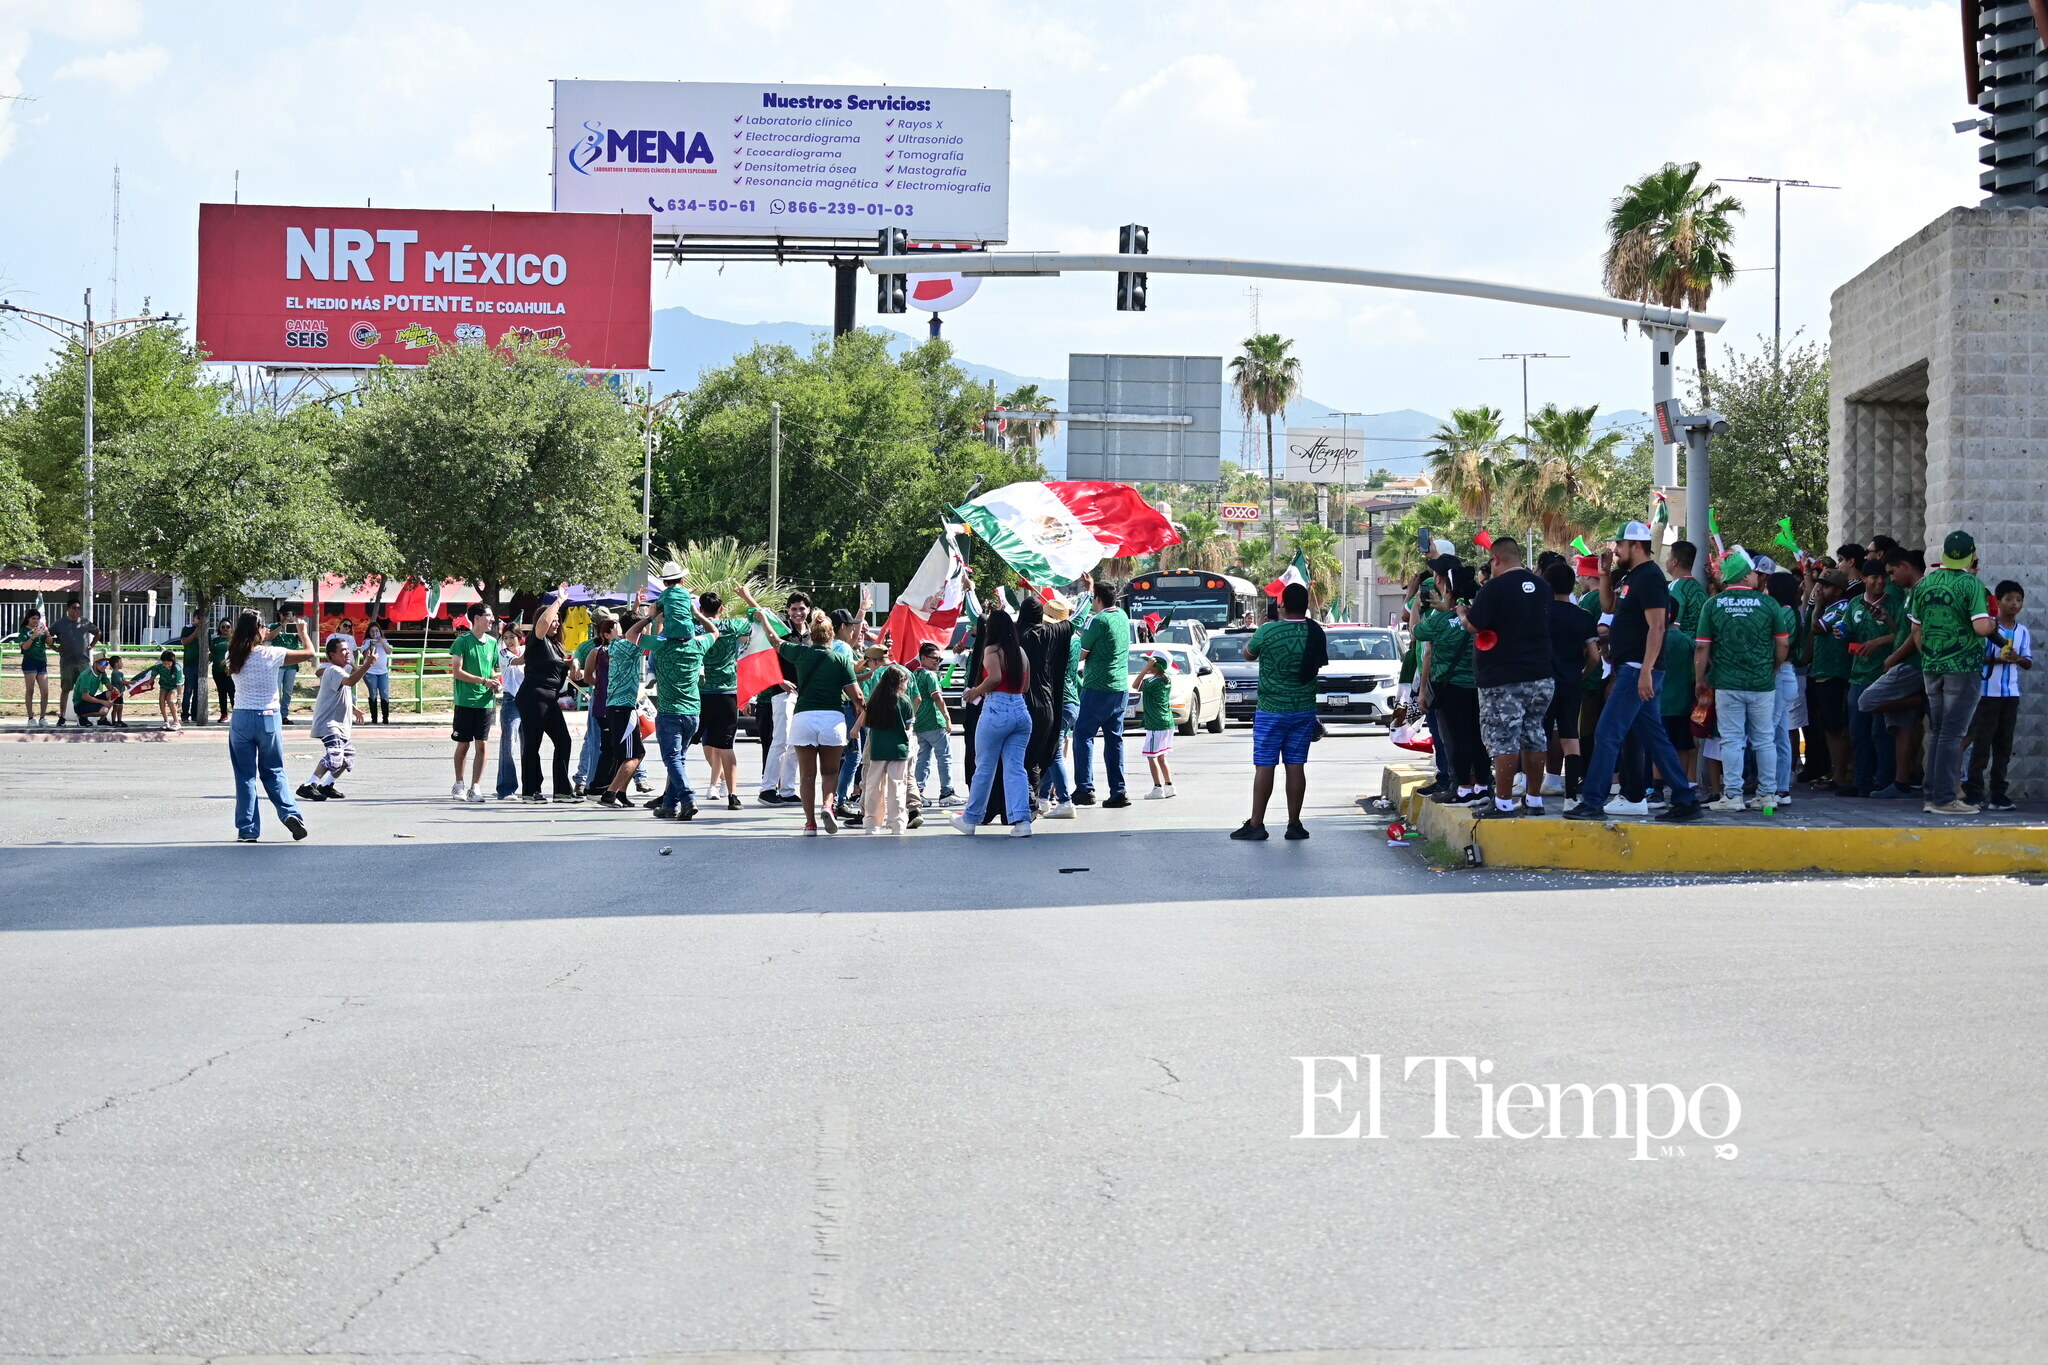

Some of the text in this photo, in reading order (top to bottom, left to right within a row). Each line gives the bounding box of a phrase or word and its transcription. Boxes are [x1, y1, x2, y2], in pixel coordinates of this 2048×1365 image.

[763, 93, 931, 111] Nuestros Servicios:
[746, 116, 853, 127] Laboratorio clínico
[898, 120, 944, 131] Rayos X
[746, 132, 861, 145] Electrocardiograma
[898, 135, 964, 144] Ultrasonido
[607, 129, 714, 164] MENA
[746, 148, 842, 160] Ecocardiograma
[898, 150, 964, 162] Tomografía
[745, 162, 857, 174] Densitometría ósea
[897, 165, 967, 178] Mastografía
[745, 177, 878, 190] Resonancia magnética
[668, 199, 755, 212] 634-50-61
[788, 201, 914, 216] 866-239-01-03
[286, 227, 567, 286] NRT MÉXICO
[286, 294, 566, 314] EL MEDIO MÁS POTENTE DE COAHUILA
[286, 319, 328, 331] CANAL
[286, 331, 328, 348] SEIS
[398, 328, 430, 341] Mejor
[415, 334, 438, 347] 96.3
[1225, 507, 1258, 519] OXXO
[1132, 602, 1143, 611] 72
[1717, 596, 1760, 607] MEJORA
